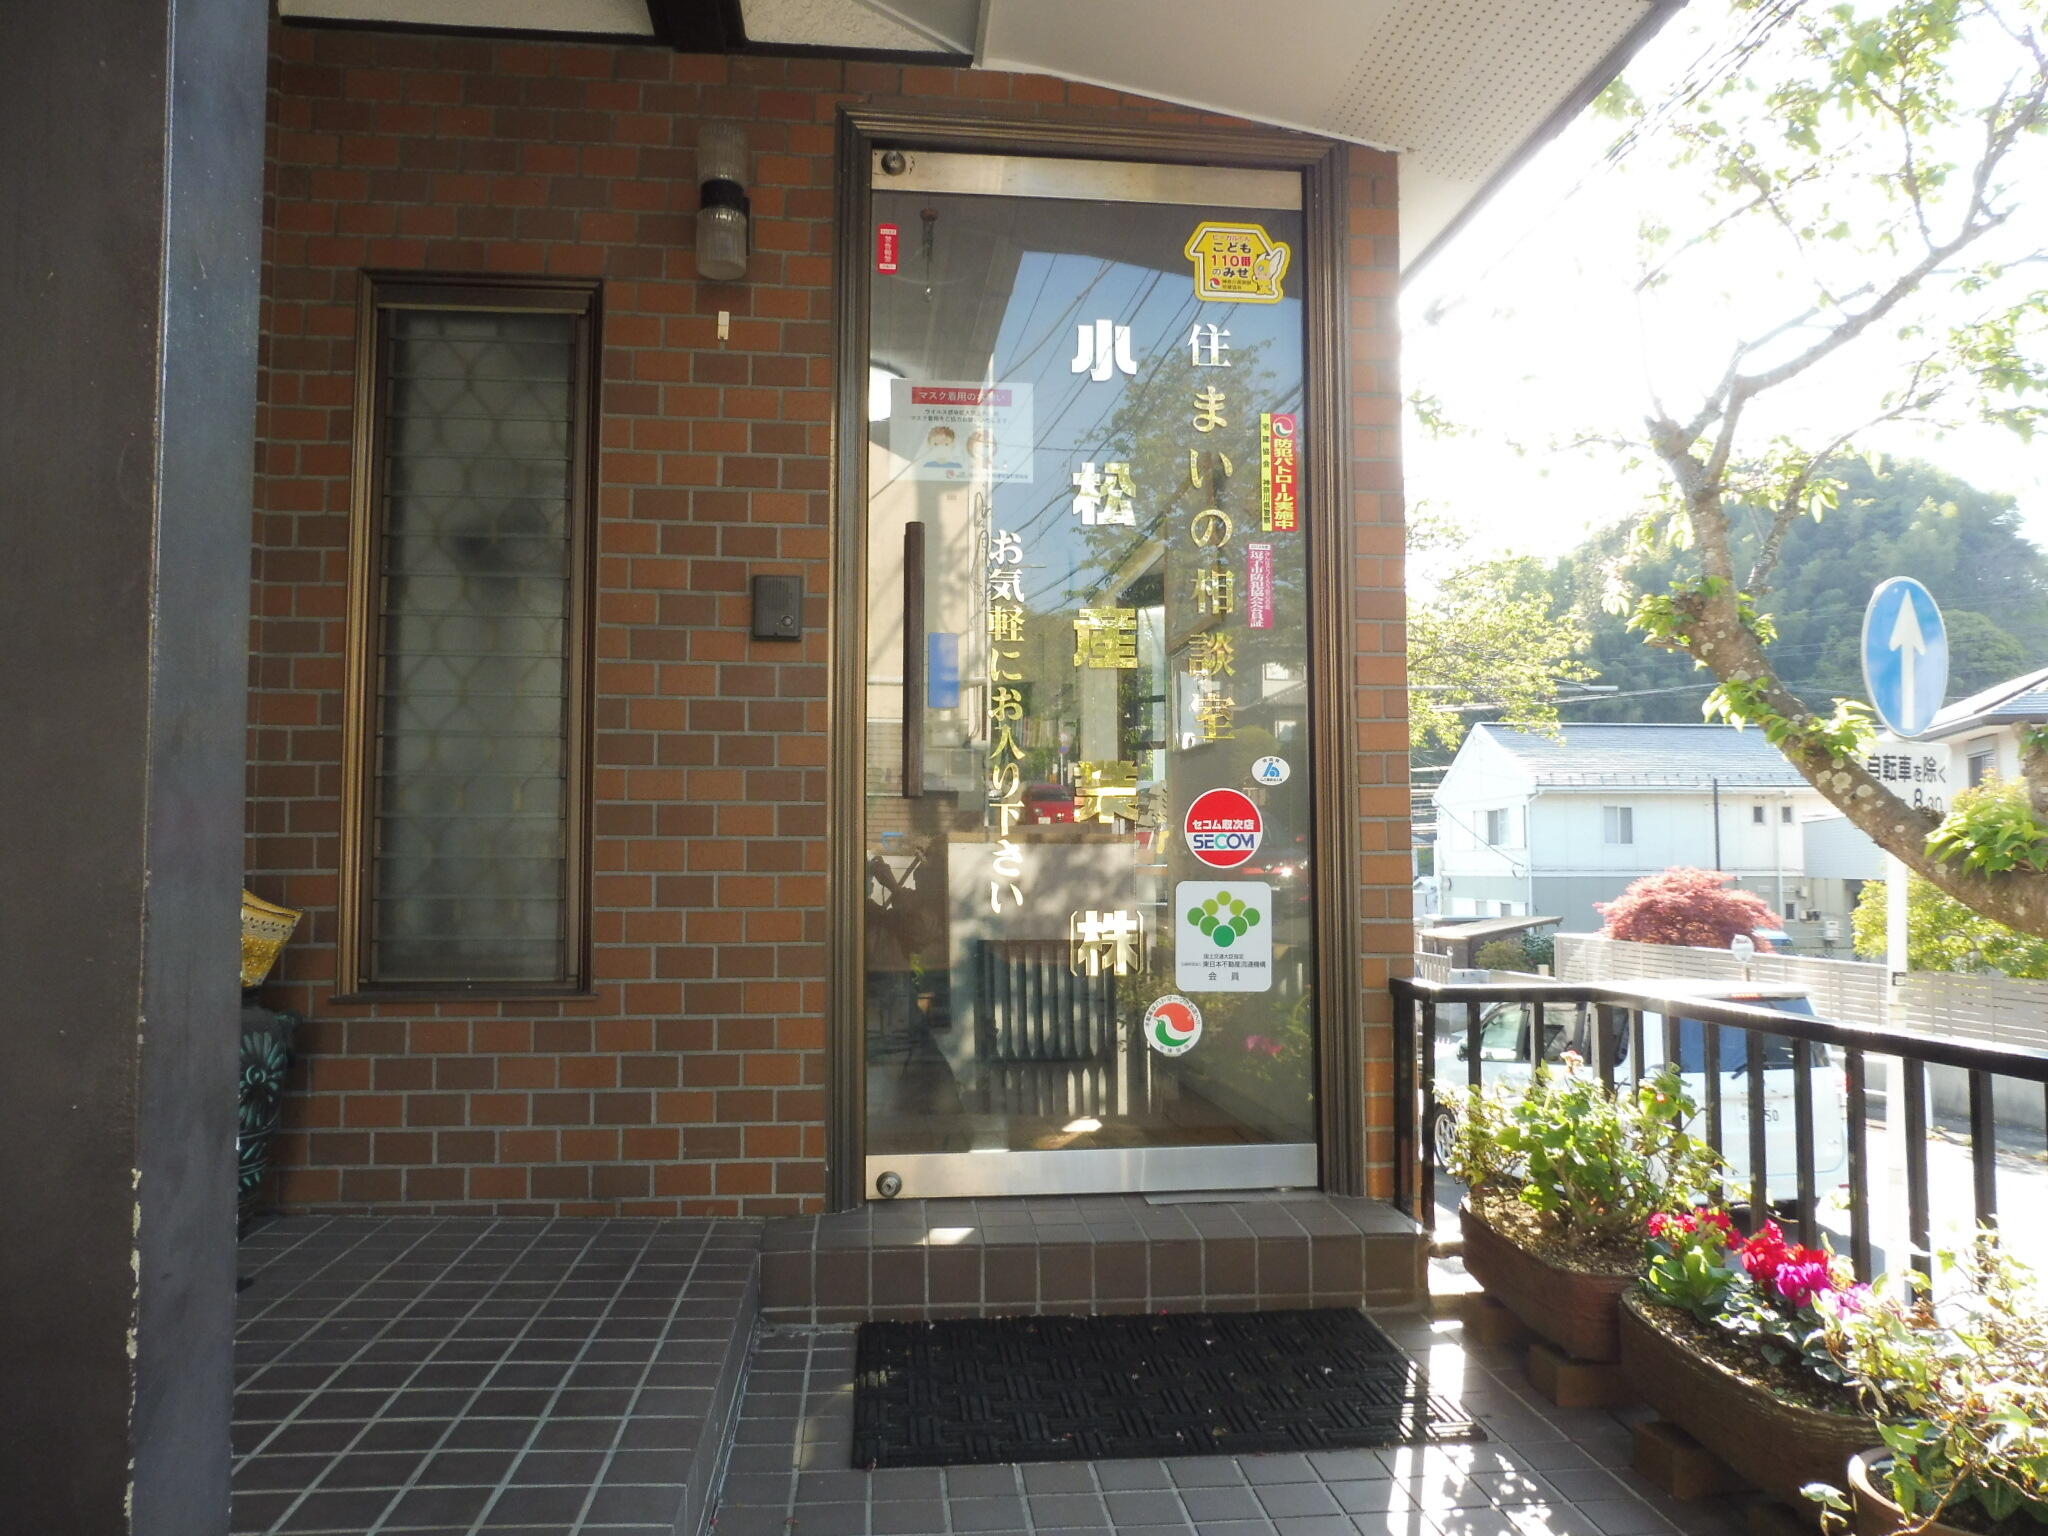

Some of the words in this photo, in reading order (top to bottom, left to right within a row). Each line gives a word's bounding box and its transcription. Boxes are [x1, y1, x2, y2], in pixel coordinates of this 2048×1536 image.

[1213, 242, 1251, 253] こども
[1211, 255, 1251, 267] 110番
[1212, 268, 1248, 278] のみせ
[1274, 438, 1295, 530] 防犯パトロール実施中
[1187, 323, 1236, 741] 住まいの相談室
[987, 529, 1026, 914] お気軽にお入り下さい
[1867, 753, 1946, 783] 自転車を除く
[1192, 819, 1255, 830] セコム取次店
[1193, 833, 1255, 849] SECOM
